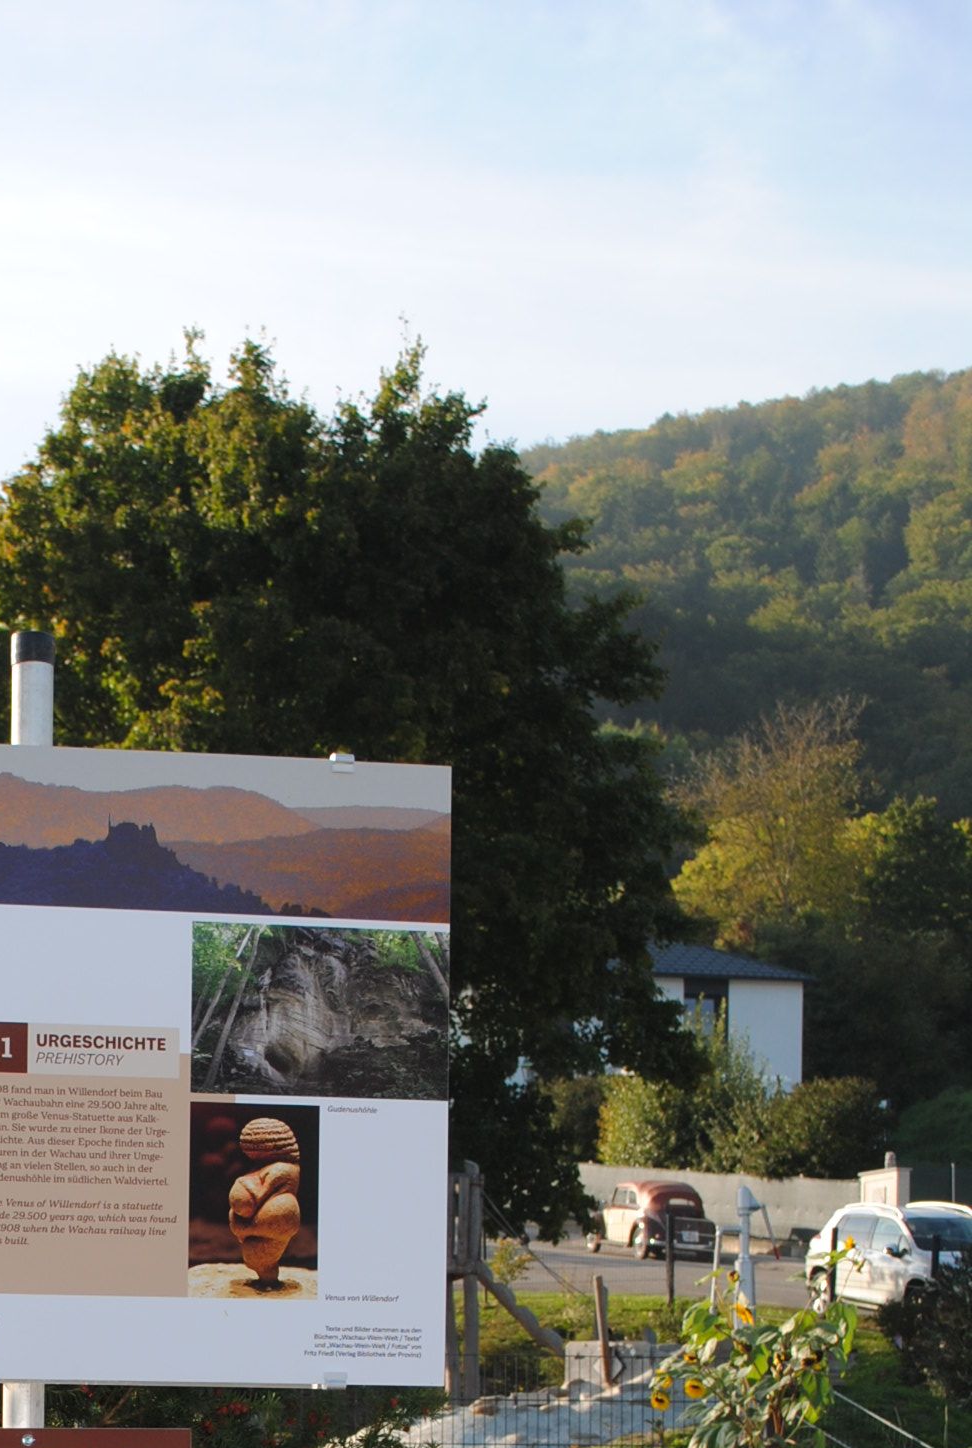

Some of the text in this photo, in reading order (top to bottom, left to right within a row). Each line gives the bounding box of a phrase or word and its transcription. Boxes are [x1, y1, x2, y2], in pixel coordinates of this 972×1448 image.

[1, 1037, 13, 1058] 1
[36, 1034, 166, 1051] URGESCHICHTE
[35, 1051, 123, 1067] PREHISTORY
[10, 1084, 32, 1094] fand
[56, 1085, 66, 1095] in
[68, 1086, 117, 1096] Willendorf
[119, 1087, 142, 1097] beim
[144, 1088, 162, 1097] Bau
[4, 1097, 64, 1108] Wachaubahn
[65, 1099, 85, 1109] eine
[87, 1100, 121, 1110] 29.500
[124, 1101, 147, 1110] Jahre
[11, 1110, 38, 1122] große
[41, 1111, 115, 1121] Venus-Statuette
[20, 1149, 29, 1158] in
[31, 1149, 46, 1158] der
[50, 1149, 87, 1159] Wachau
[88, 1150, 107, 1159] und
[109, 1151, 130, 1160] ihrer
[53, 1174, 65, 1183] im
[67, 1175, 112, 1184] südlichen
[6, 1199, 35, 1208] Venus
[36, 1199, 45, 1208] of
[48, 1200, 100, 1210] Willendorf
[102, 1201, 111, 1210] is
[121, 1201, 163, 1211] statuette
